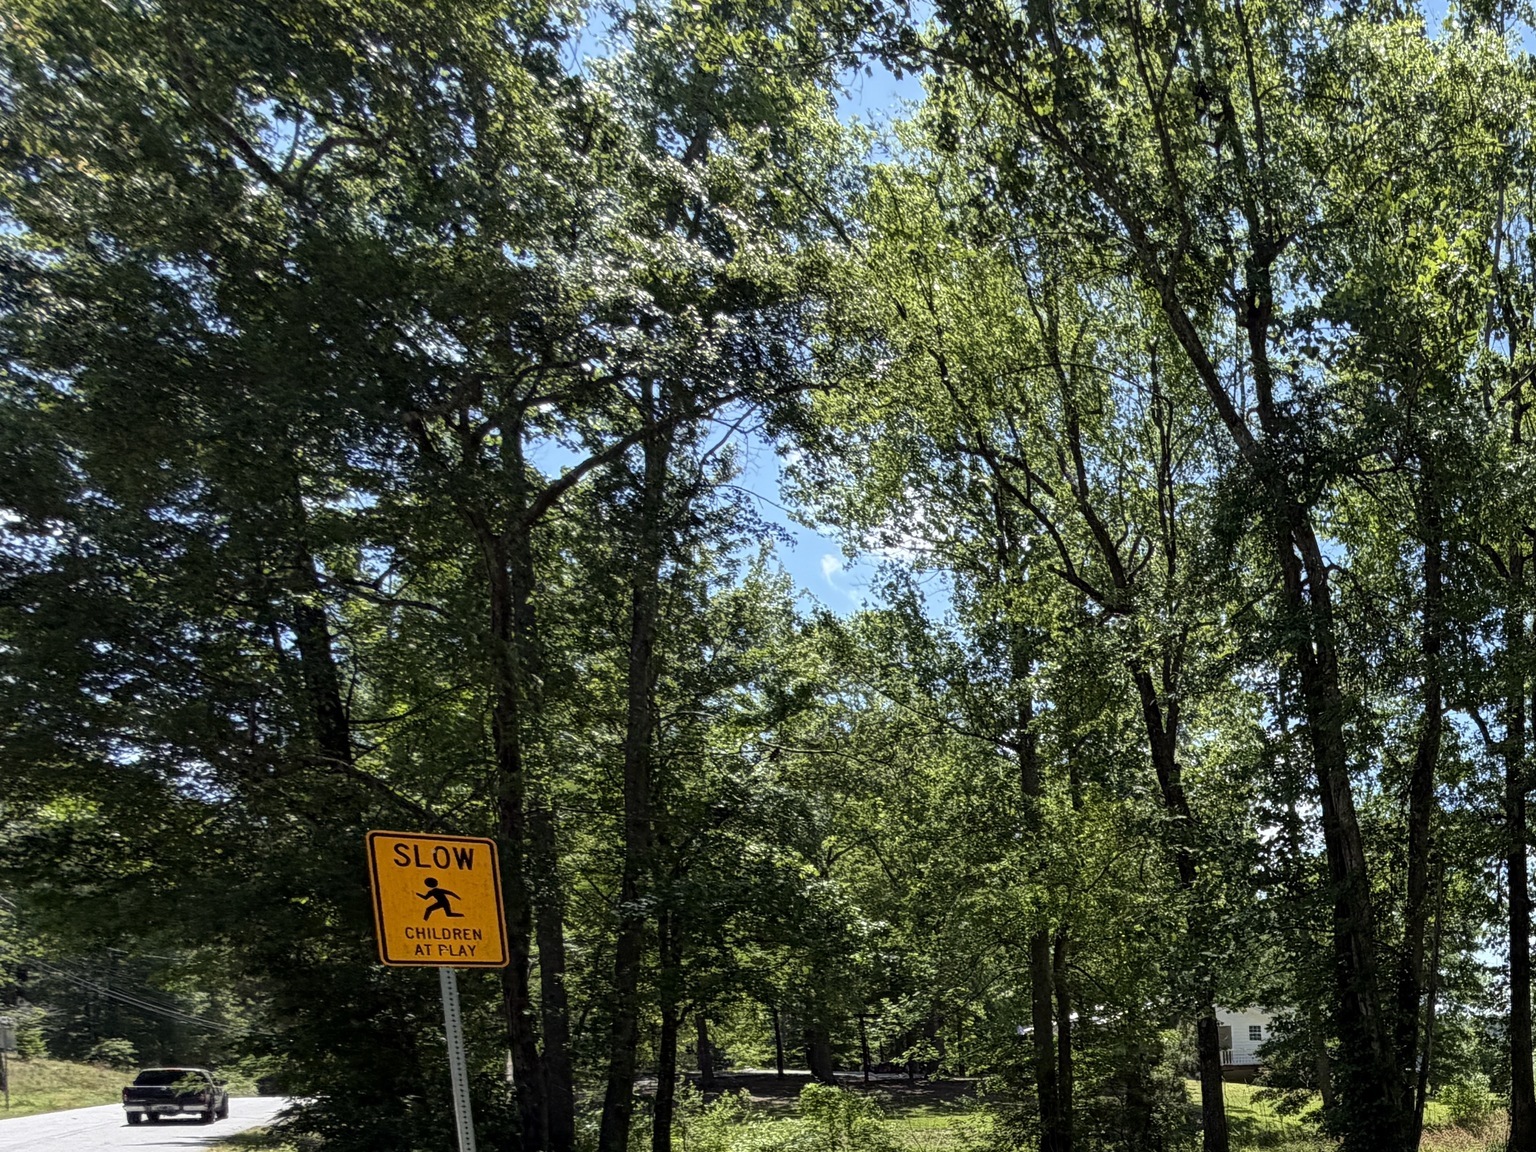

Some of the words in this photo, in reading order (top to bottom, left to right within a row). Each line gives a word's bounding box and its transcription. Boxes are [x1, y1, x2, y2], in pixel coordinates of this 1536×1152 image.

[393, 843, 474, 870] SLOW
[405, 927, 482, 940] CHILDREN
[414, 944, 432, 956] AT
[438, 944, 476, 957] PLAY
